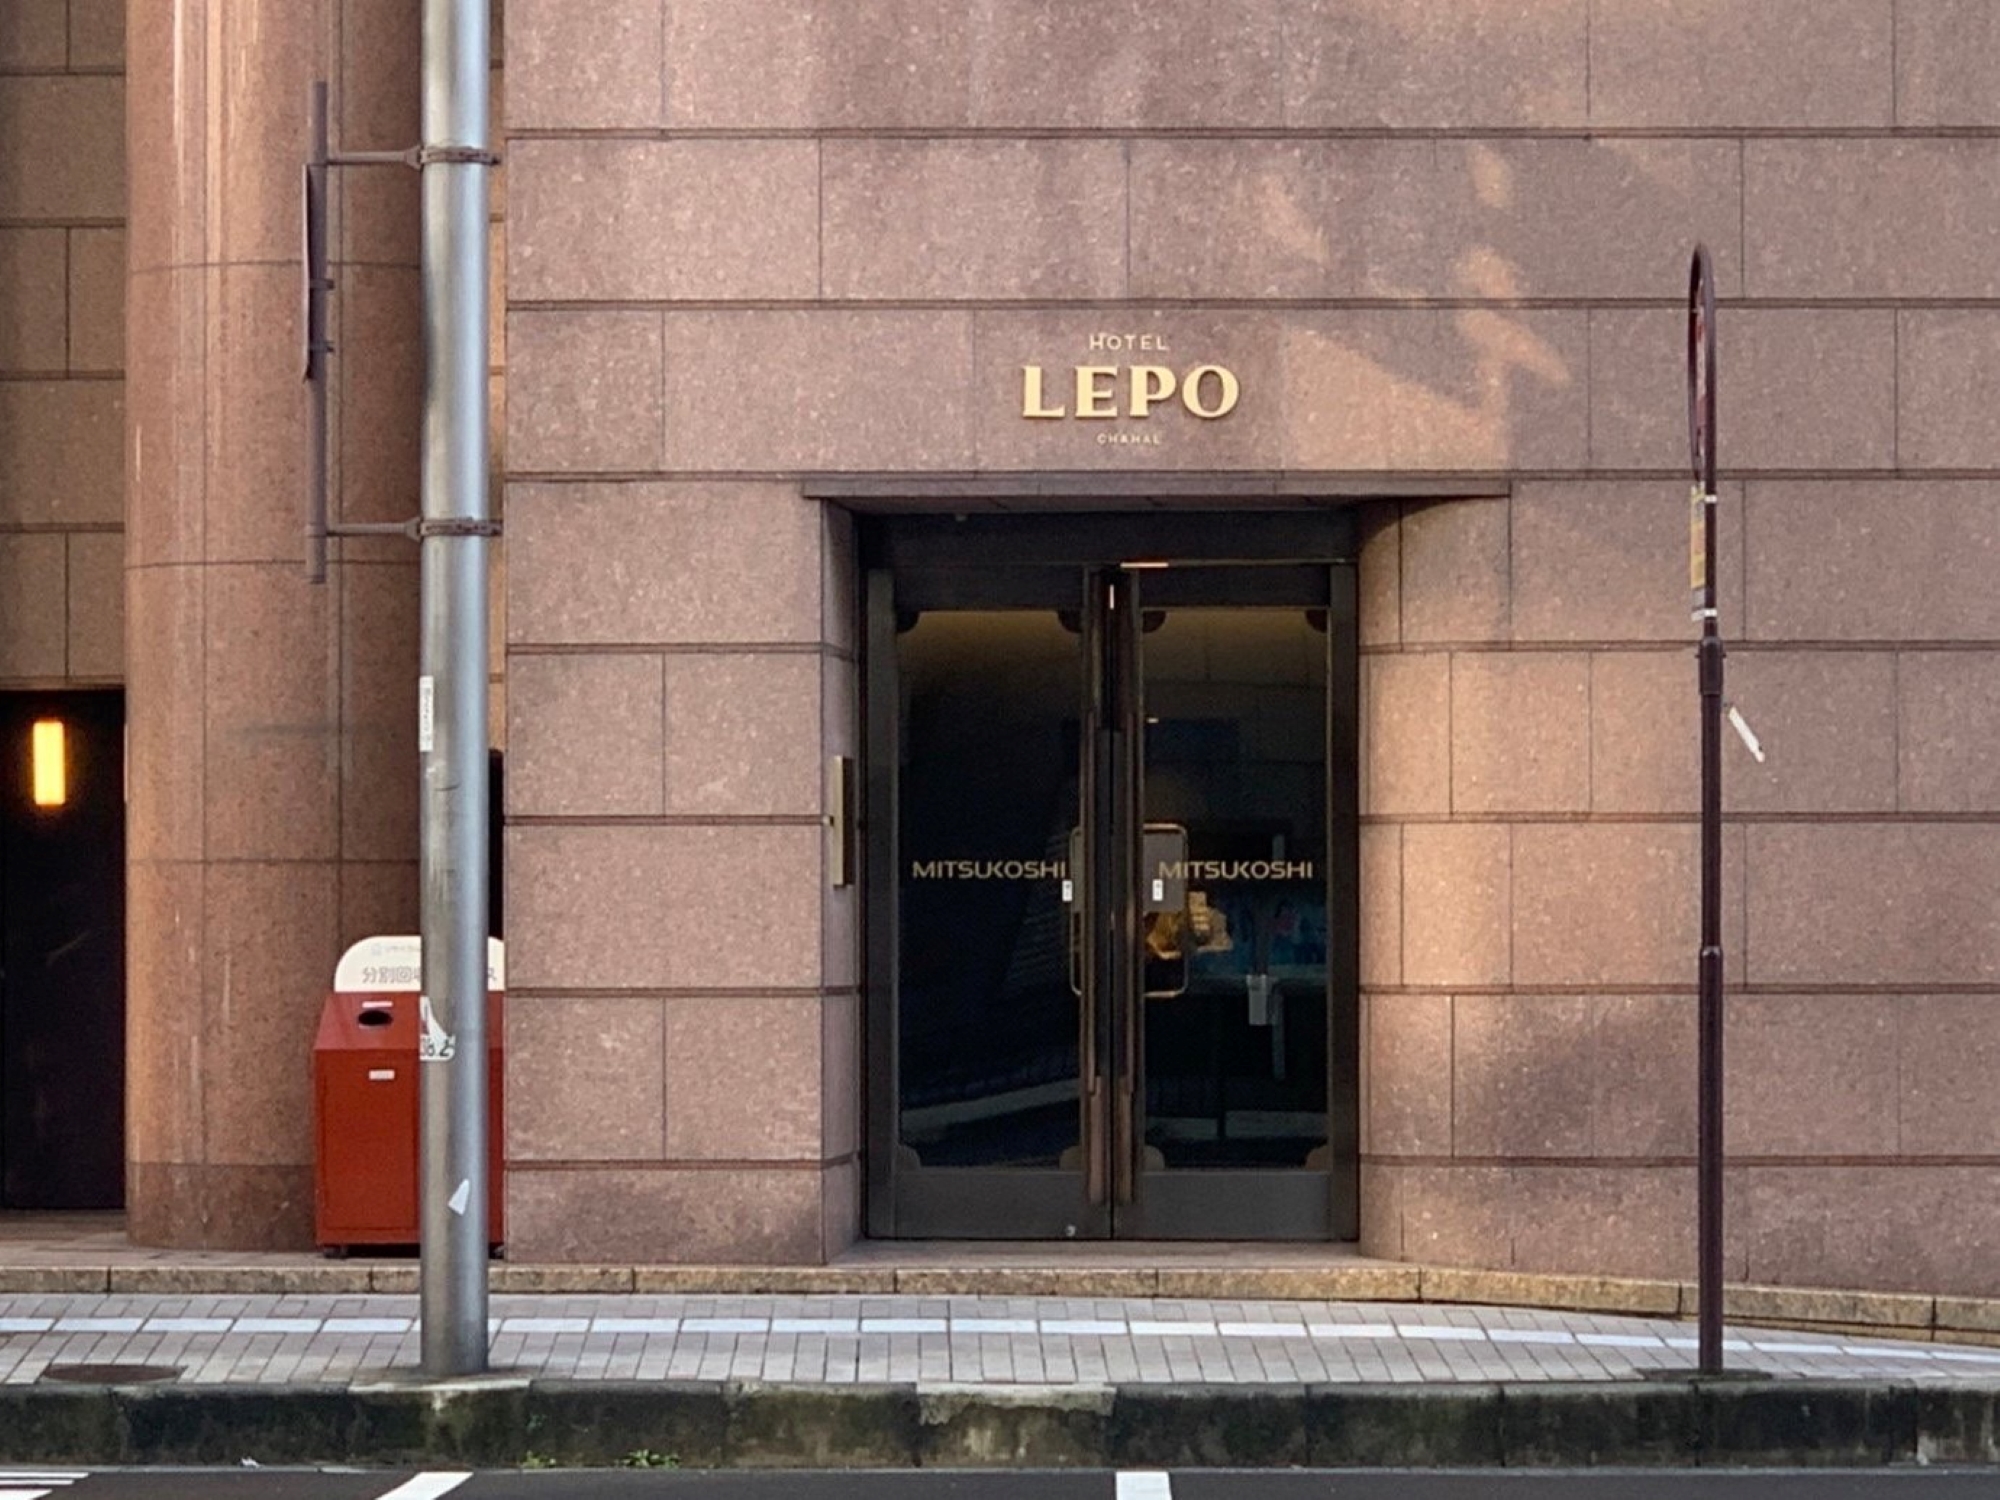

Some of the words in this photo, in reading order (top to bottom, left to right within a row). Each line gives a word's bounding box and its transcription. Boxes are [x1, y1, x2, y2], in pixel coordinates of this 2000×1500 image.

[1089, 335, 1168, 350] HOTEL
[1022, 365, 1240, 418] LEPO
[912, 861, 1066, 879] MITSUKOSHI
[1159, 861, 1313, 879] MITSUKOSHI
